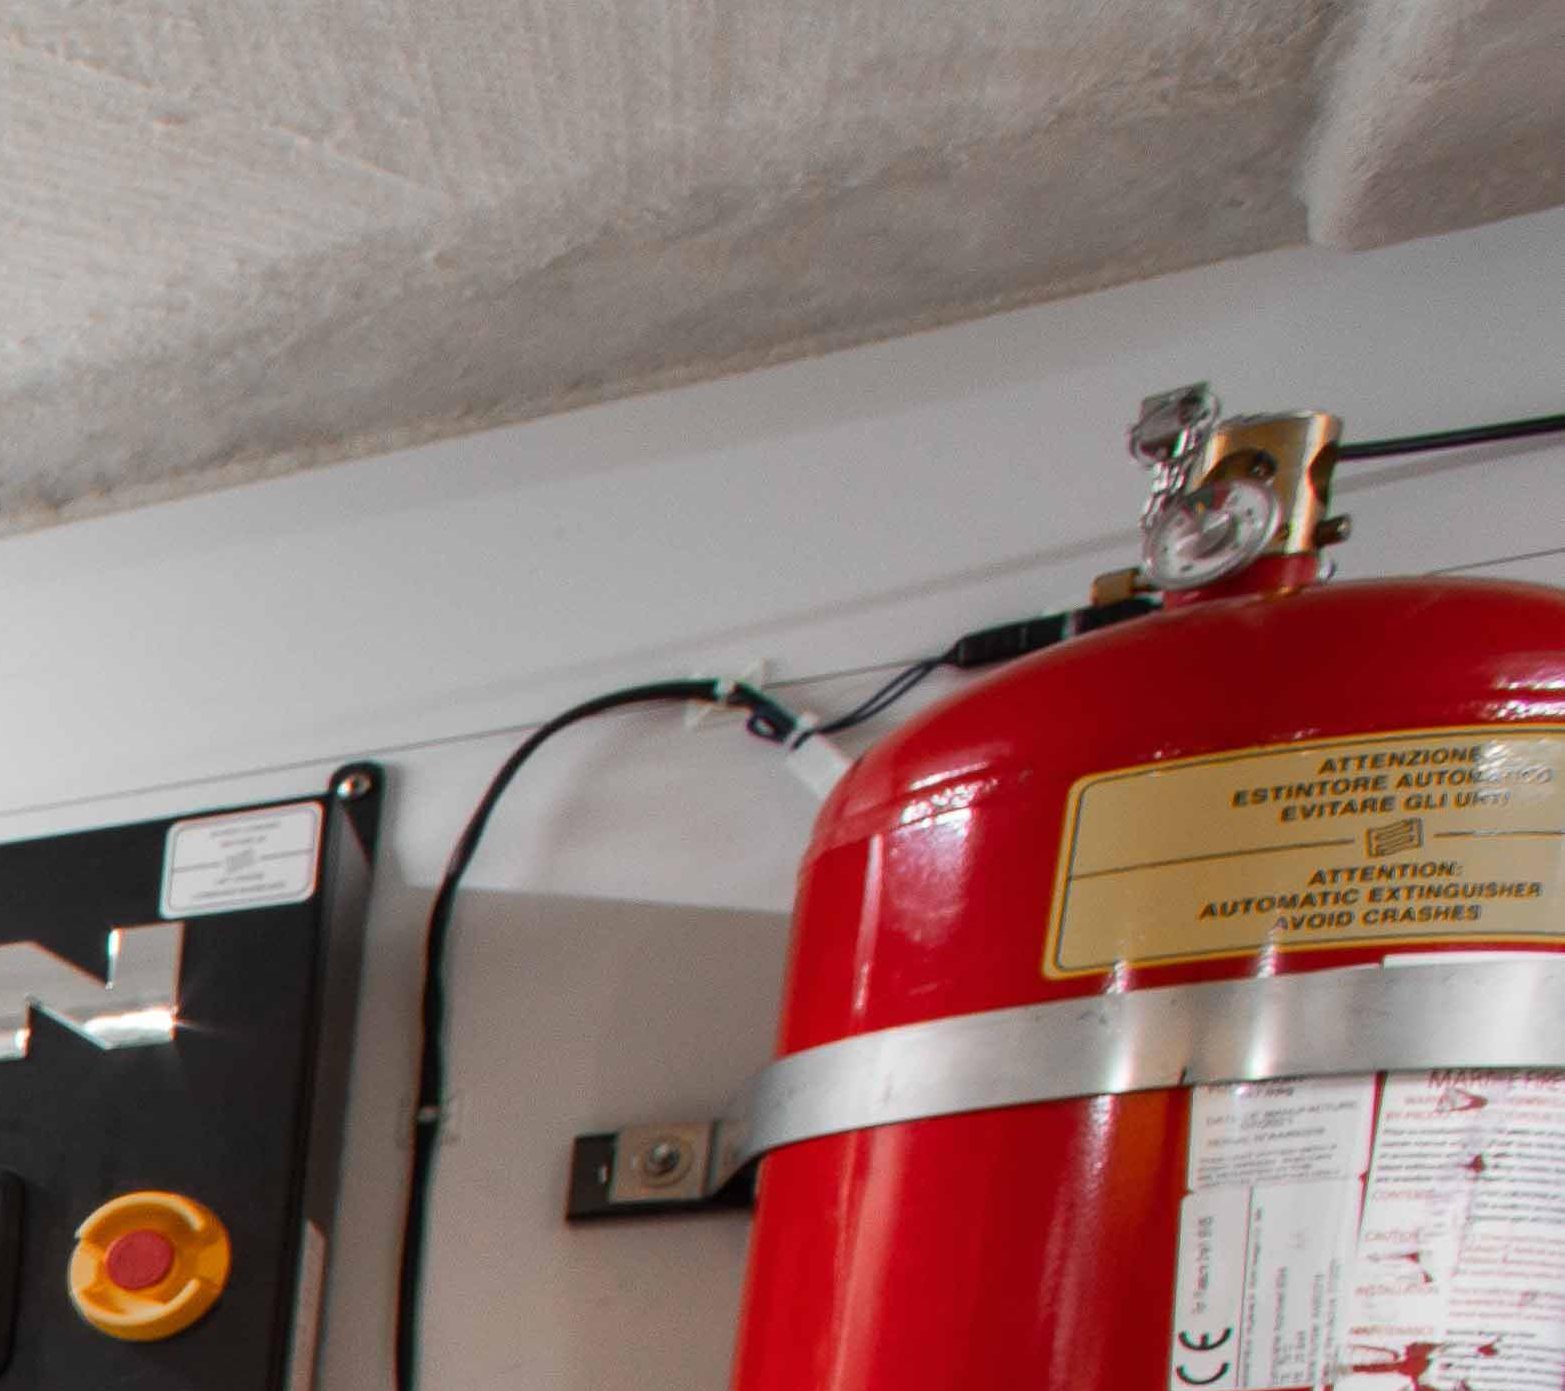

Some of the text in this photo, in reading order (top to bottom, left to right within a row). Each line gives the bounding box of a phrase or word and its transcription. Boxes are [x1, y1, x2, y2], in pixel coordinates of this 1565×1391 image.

[1231, 775, 1388, 808] ESTINTORE
[1279, 795, 1396, 823] EVITARE
[1403, 792, 1449, 812] GLI
[1199, 881, 1544, 920] AUTOMATIC EXTINGUISHER
[1274, 904, 1481, 932] AVOID CRASHES
